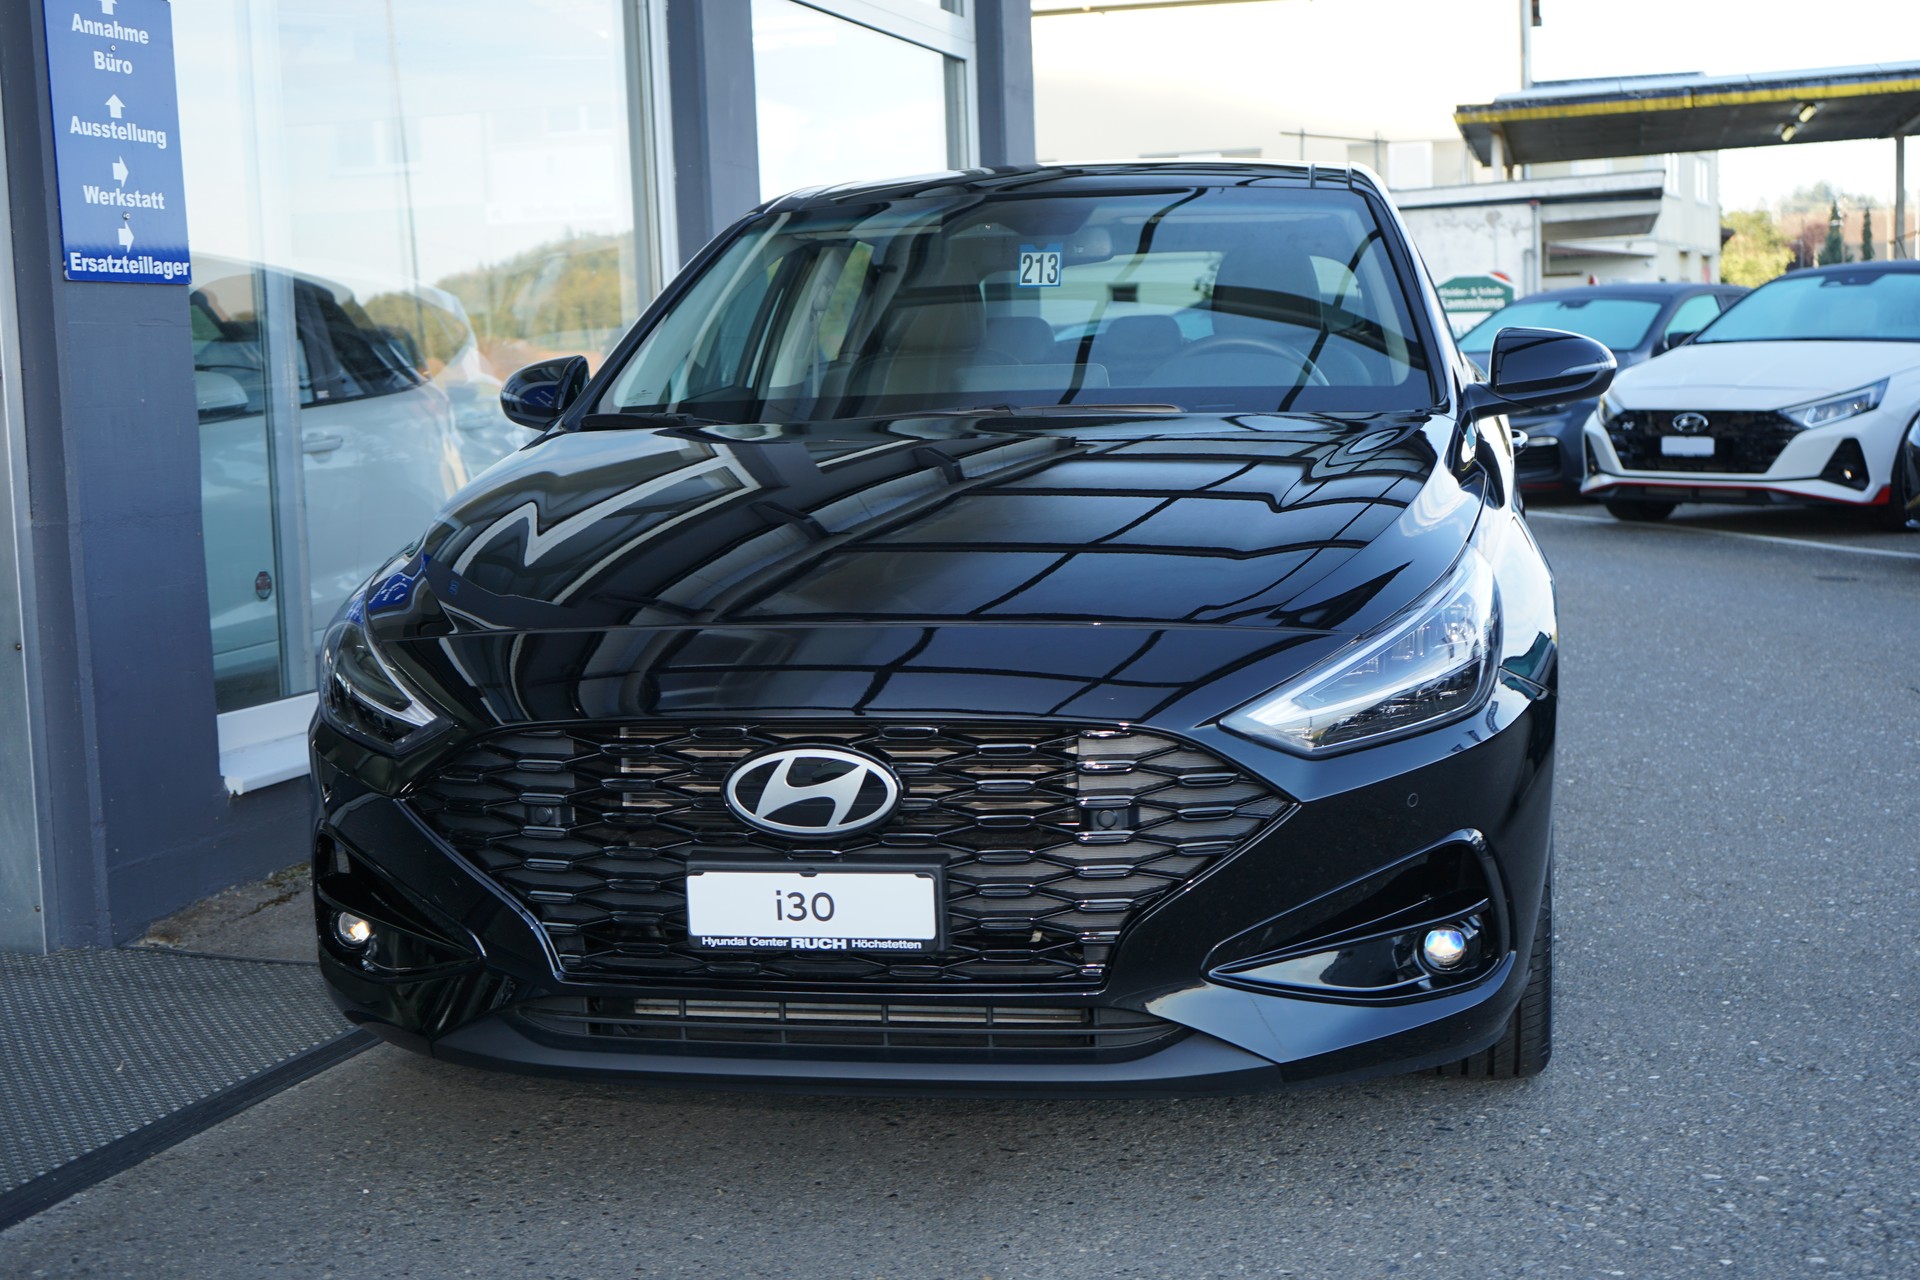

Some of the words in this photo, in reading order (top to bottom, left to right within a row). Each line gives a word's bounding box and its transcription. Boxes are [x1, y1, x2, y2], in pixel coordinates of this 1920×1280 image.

[71, 13, 149, 45] Annahme
[93, 51, 133, 75] Büro
[69, 115, 167, 149] Ausstellung
[83, 185, 165, 210] Werkstatt
[69, 252, 190, 280] Ersatzteillager
[1021, 253, 1059, 284] 213
[775, 889, 835, 922] i30
[701, 936, 748, 948] Hyundai
[749, 937, 790, 947] Center
[791, 937, 847, 950] RUCH
[851, 939, 922, 950] Höchstetten
